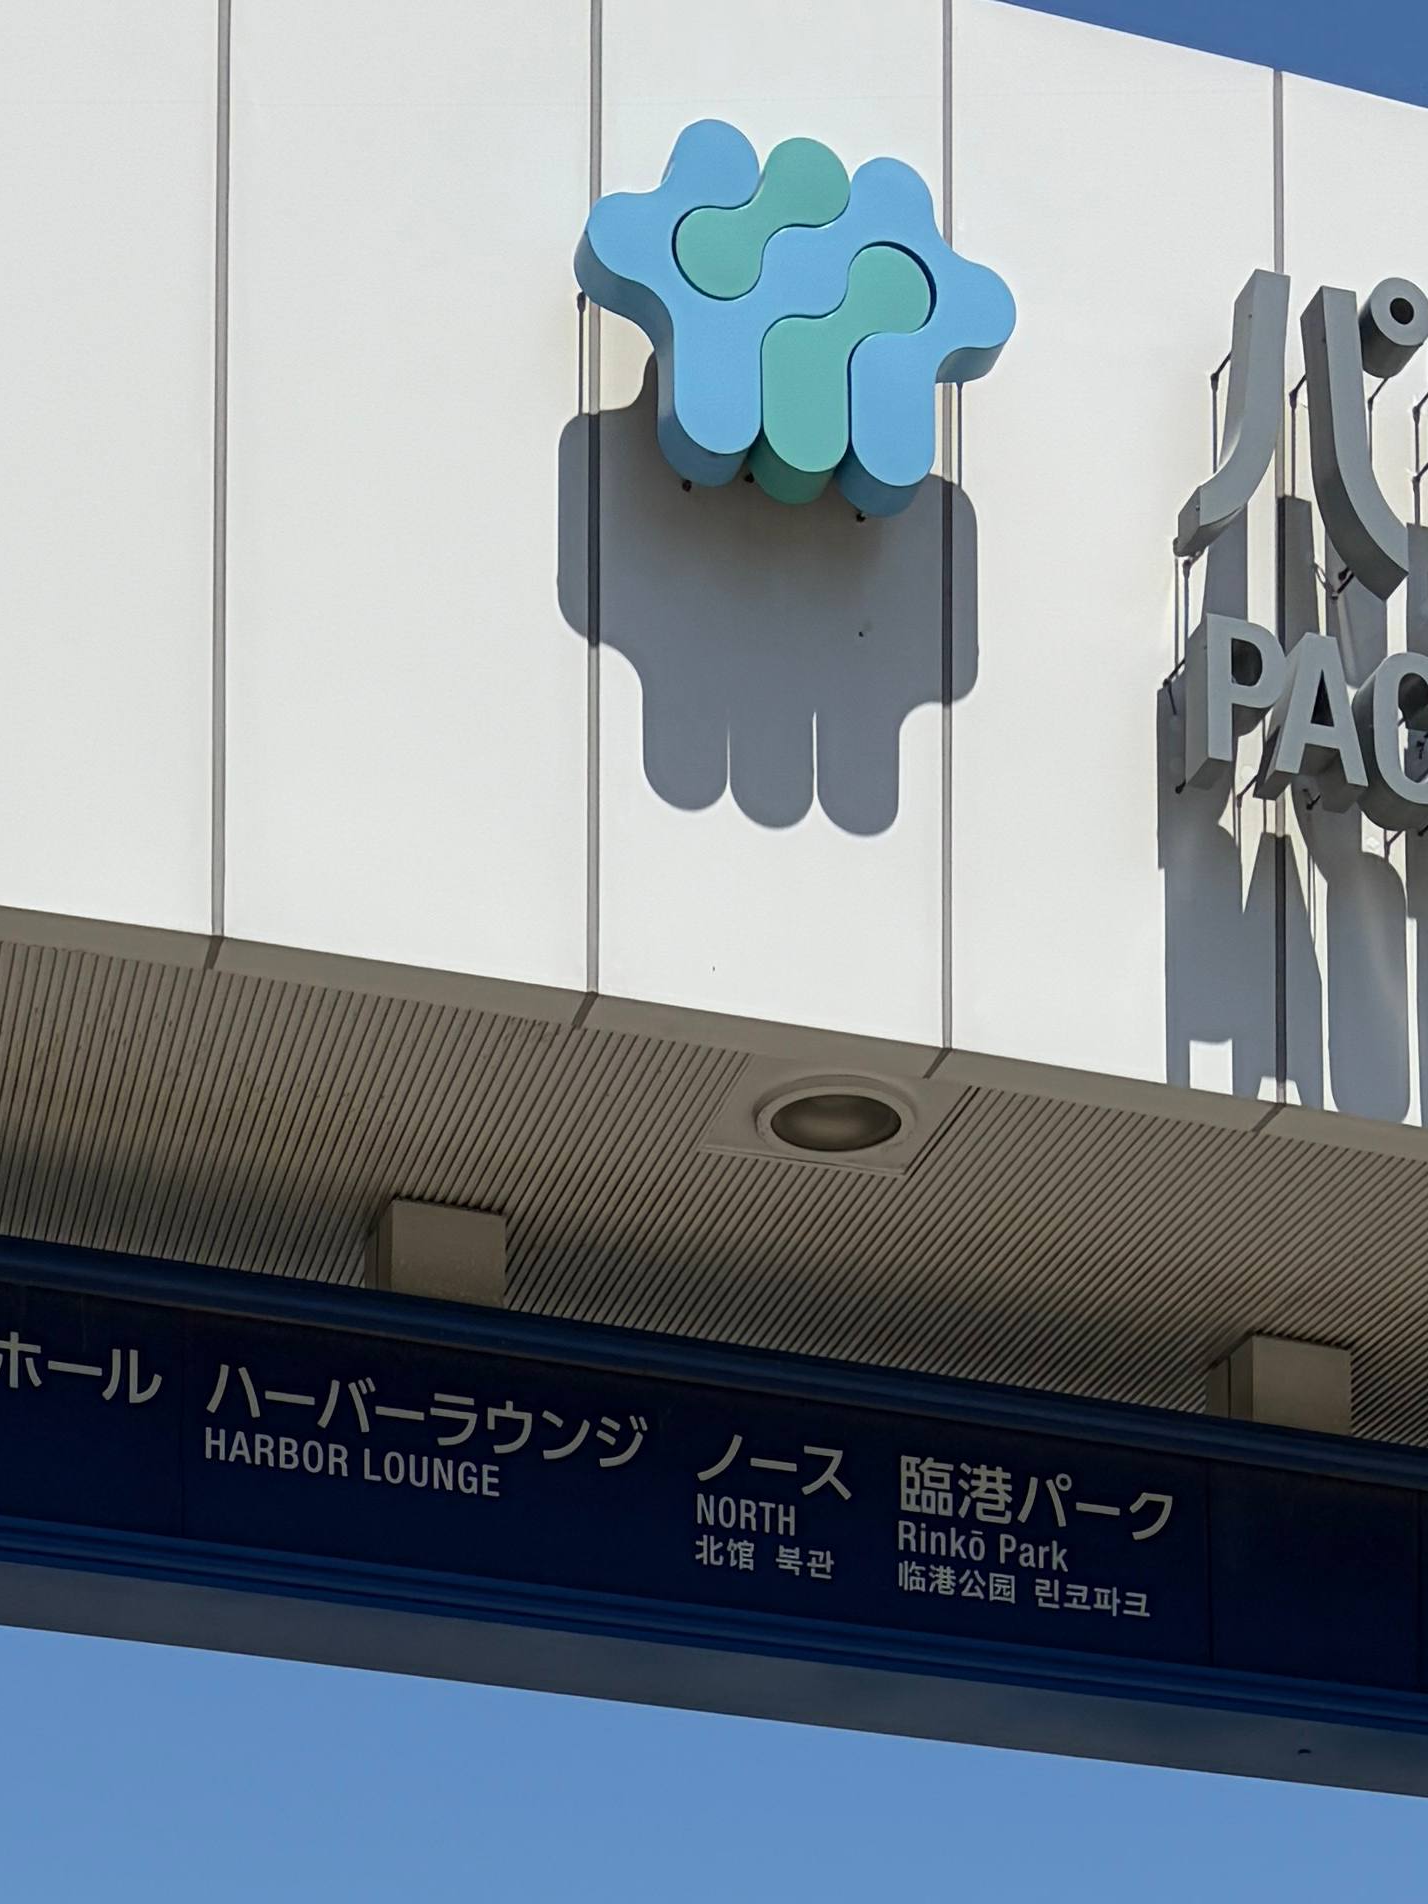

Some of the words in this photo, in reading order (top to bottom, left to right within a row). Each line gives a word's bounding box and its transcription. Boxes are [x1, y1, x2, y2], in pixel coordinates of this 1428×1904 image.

[207, 1364, 648, 1467] ハーバーラウンジ
[205, 1427, 349, 1477] HARBOR
[363, 1448, 500, 1497] LOUNGE
[697, 1434, 852, 1500] ノース
[696, 1494, 796, 1536] NORTH
[899, 1455, 1173, 1541] 臨港パーク
[695, 1535, 754, 1571] 北馆
[776, 1546, 834, 1580] 북관
[898, 1521, 986, 1561] Rinkō
[1000, 1534, 1068, 1572] Park
[898, 1561, 1016, 1604] 临港公园
[1035, 1580, 1151, 1617] 린코파크
